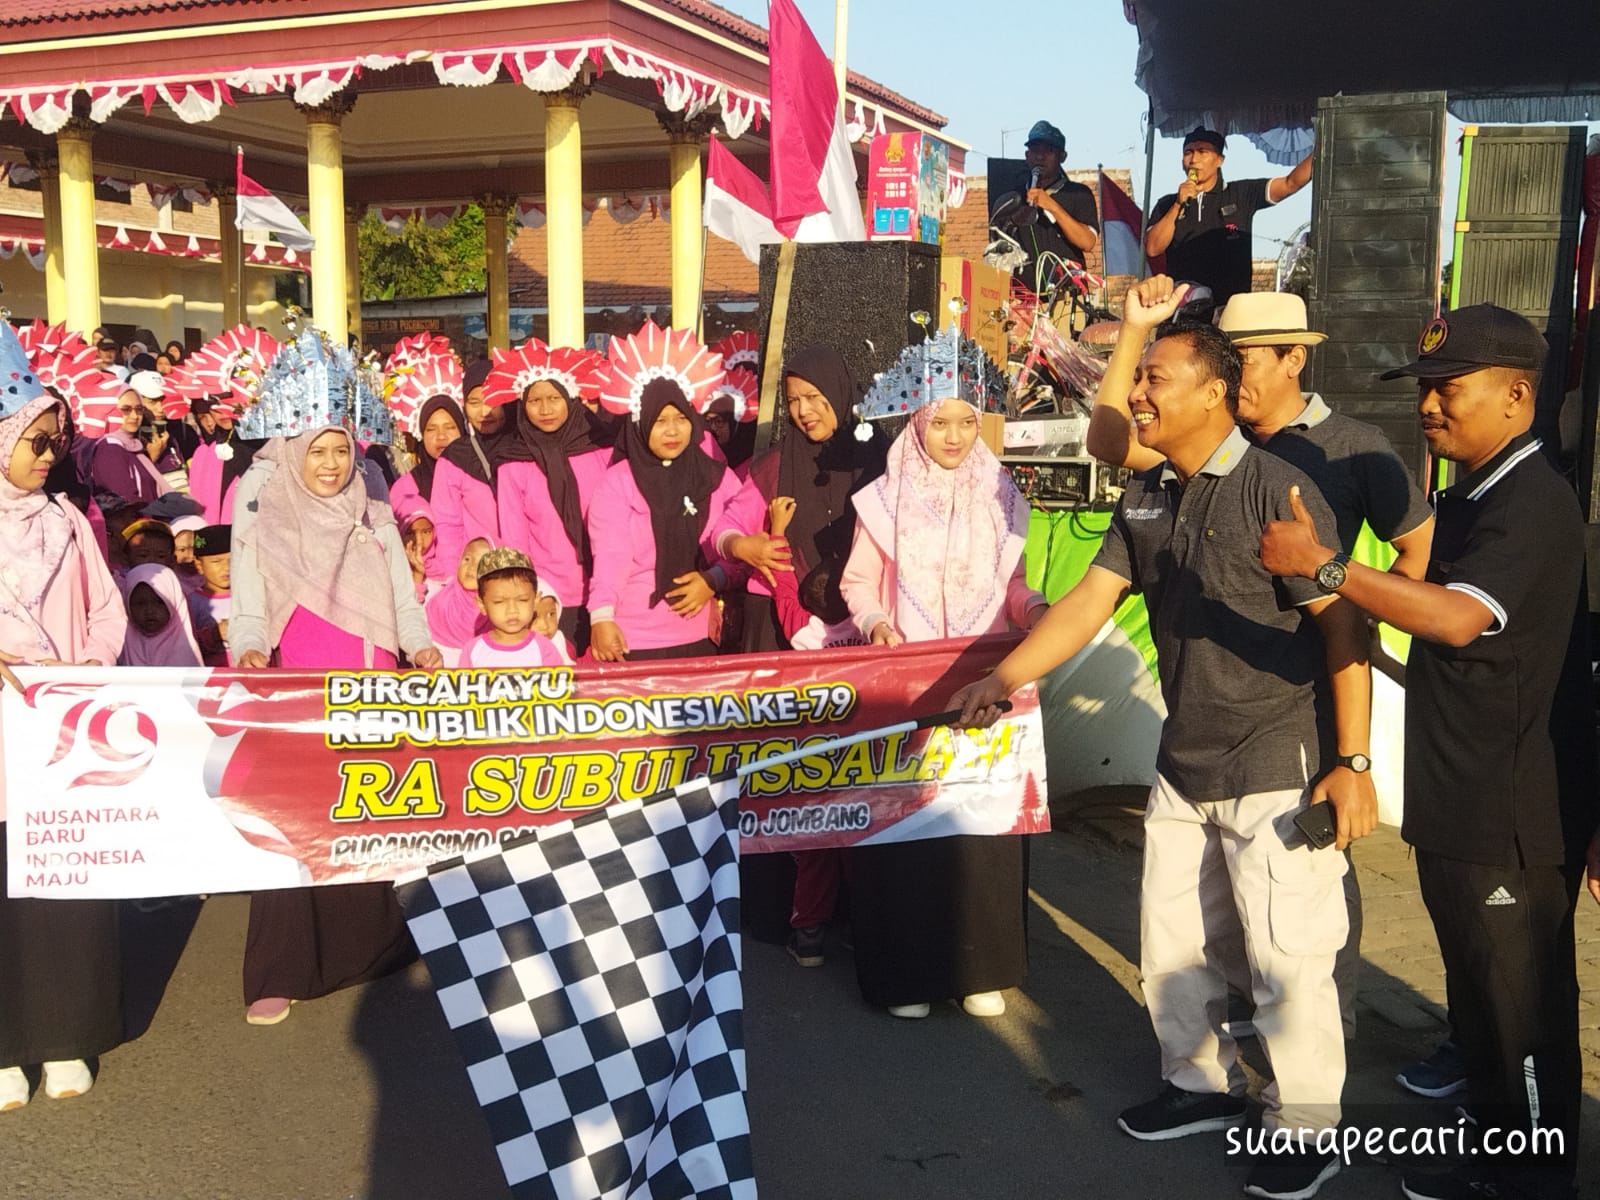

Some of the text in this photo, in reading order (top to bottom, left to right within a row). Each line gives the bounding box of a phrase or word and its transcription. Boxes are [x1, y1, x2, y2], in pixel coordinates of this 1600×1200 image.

[328, 670, 571, 706] DIRGAHAYU
[328, 685, 854, 745] REPUBLIK INDONESIA KE-79
[331, 759, 443, 820] RA
[25, 806, 160, 827] NUSANTARA
[26, 828, 86, 846] BARU
[331, 830, 491, 866] PUCANGSIMO
[761, 803, 869, 836] JOMBANG
[26, 849, 146, 869] INDONESIA
[26, 870, 89, 888] MAJU
[1485, 897, 1517, 905] adidas
